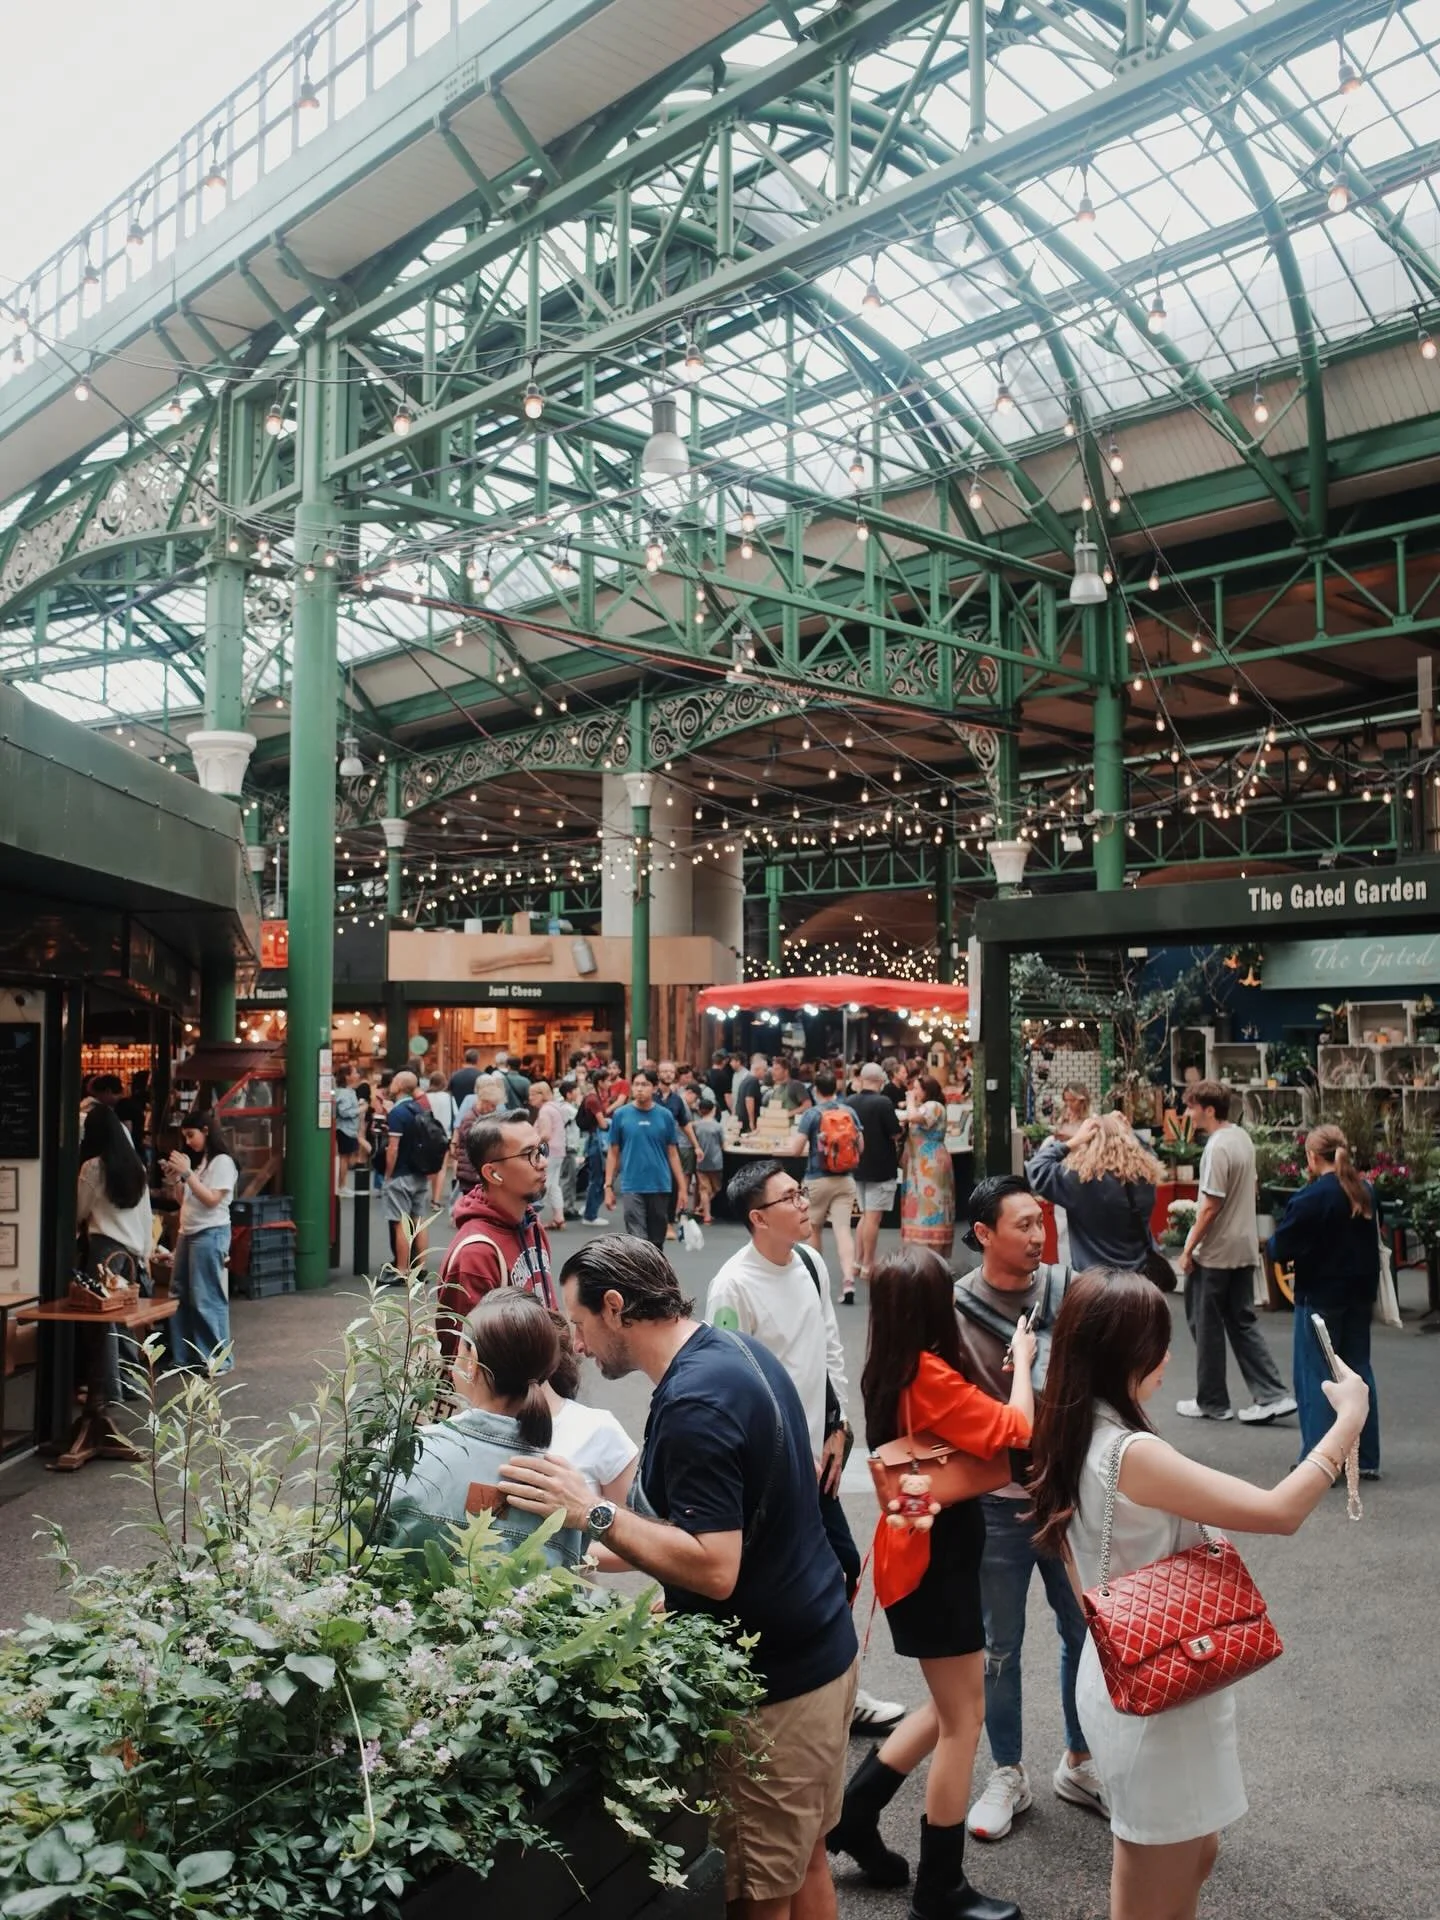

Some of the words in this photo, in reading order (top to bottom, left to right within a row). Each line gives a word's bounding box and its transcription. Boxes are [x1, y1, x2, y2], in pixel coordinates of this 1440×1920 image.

[1248, 887, 1283, 912] The
[1290, 881, 1345, 909] Gated
[1354, 876, 1427, 904] Garden
[1310, 938, 1350, 969] The
[1359, 934, 1440, 978] Gated
[511, 985, 542, 997] Cheese
